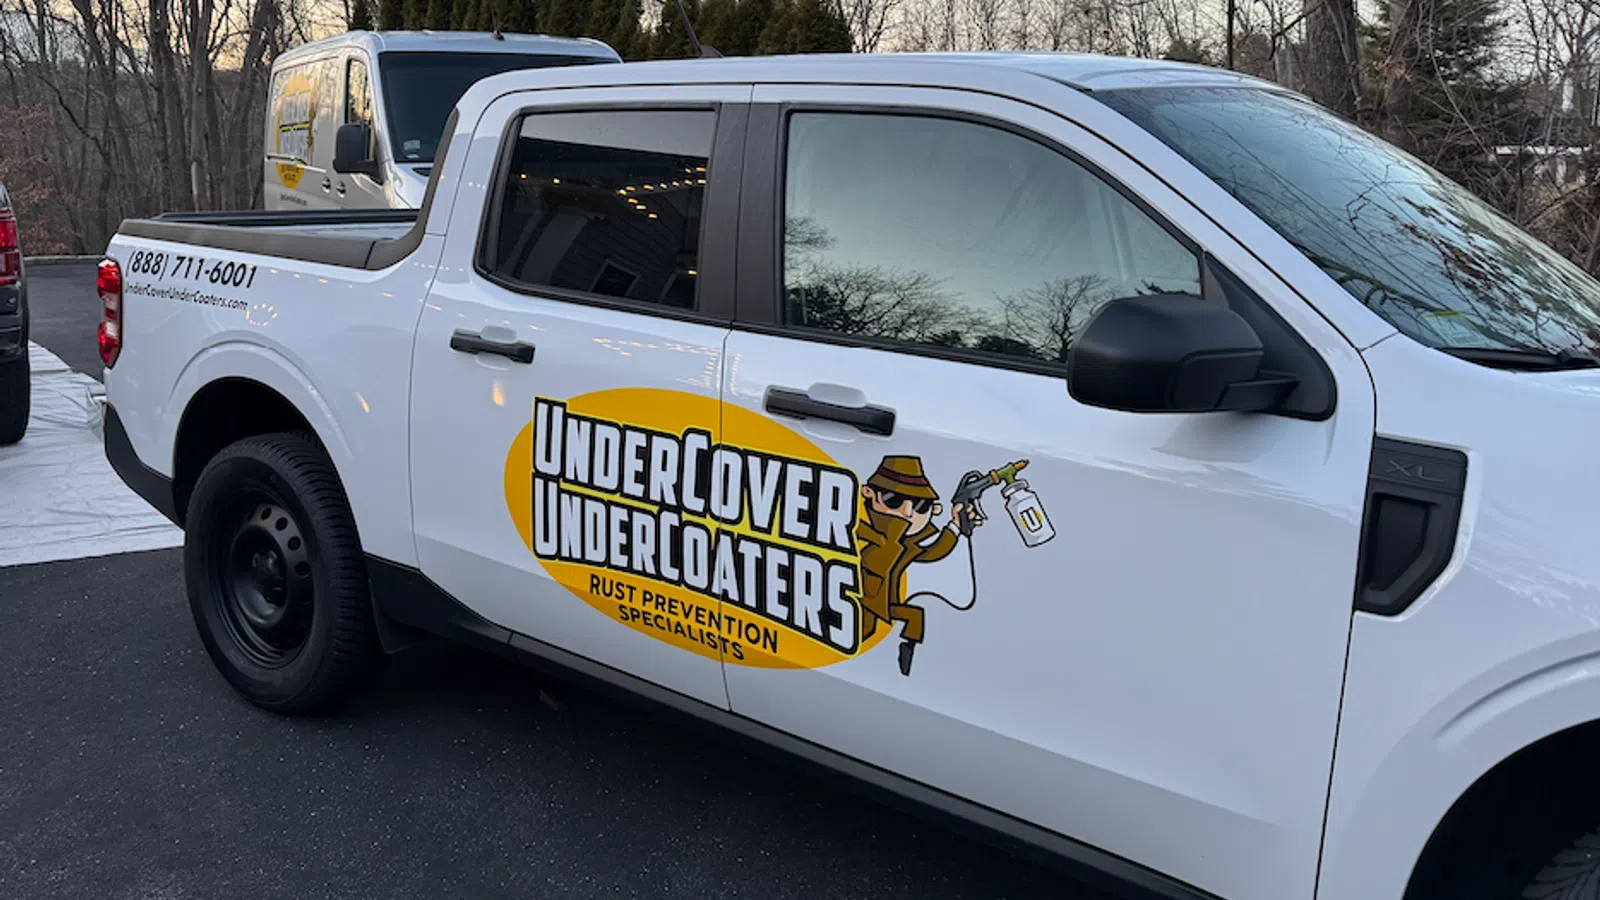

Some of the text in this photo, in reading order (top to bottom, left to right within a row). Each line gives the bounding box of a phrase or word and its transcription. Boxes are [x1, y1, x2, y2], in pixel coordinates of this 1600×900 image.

[125, 250, 257, 288] (888) 711-6001
[533, 400, 857, 550] UNDERCOVER
[1384, 459, 1445, 482] XL
[533, 477, 860, 649] UNDERCOATERS
[590, 573, 778, 653] RUST PREVENTION
[619, 604, 744, 660] SPECIALISTS
